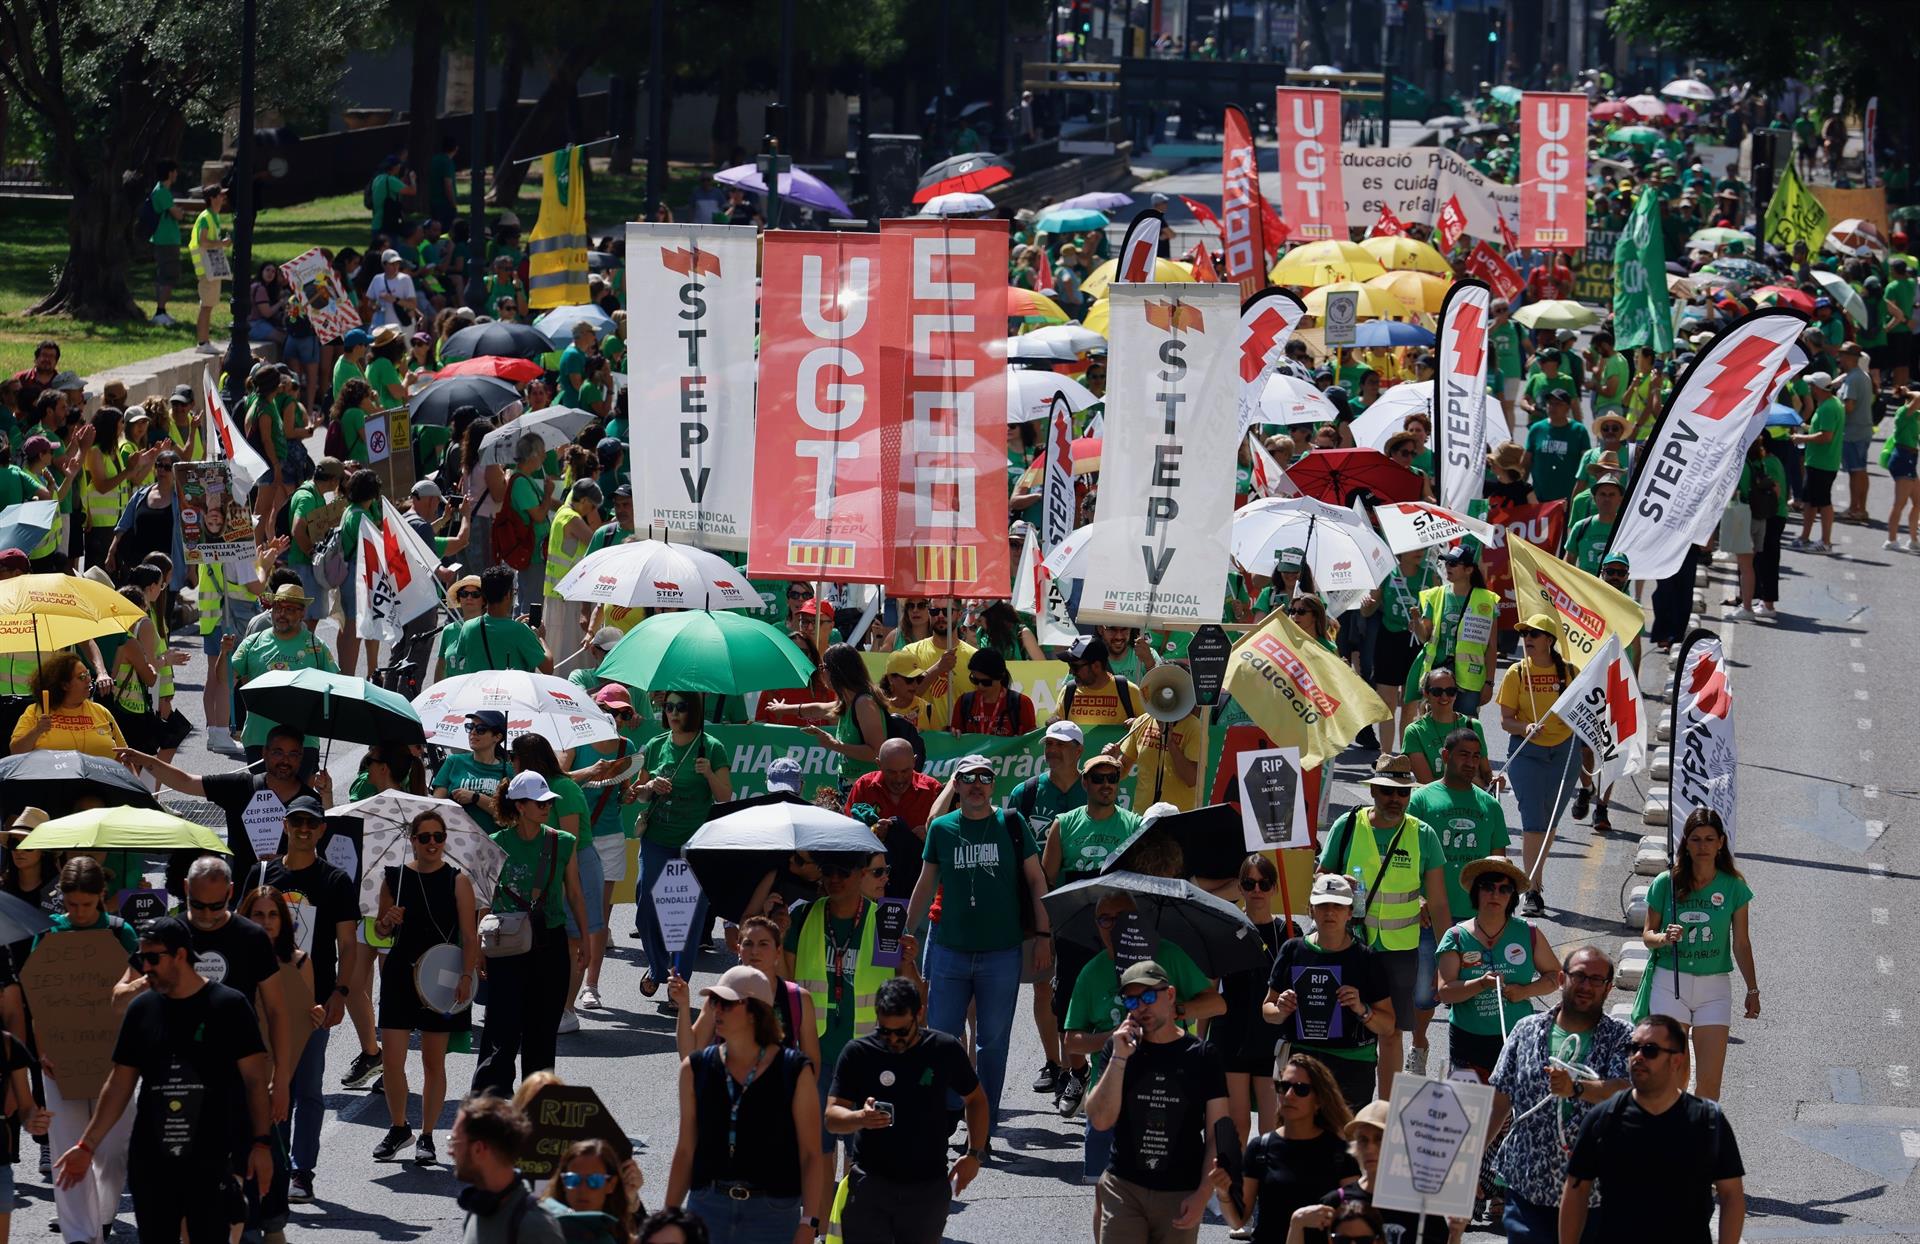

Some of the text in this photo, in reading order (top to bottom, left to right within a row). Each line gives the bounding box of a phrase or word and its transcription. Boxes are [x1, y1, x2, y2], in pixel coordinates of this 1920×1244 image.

[1293, 98, 1326, 218] UGT
[1537, 102, 1570, 221] UGT
[1363, 176, 1383, 190] es
[1363, 200, 1383, 212] es
[678, 283, 711, 503] STEPV
[795, 255, 869, 519] UGT
[391, 414, 408, 422] CAUTION
[1447, 379, 1470, 470] STEPV
[1141, 340, 1188, 585] STEPV
[1638, 419, 1700, 524] STEPV
[1663, 435, 1716, 530] INTERSINDICAL
[1684, 441, 1728, 518] VALENCIANA
[1048, 467, 1069, 546] STEPV
[653, 508, 736, 524] INTERSINDICAL
[667, 521, 736, 535] VALENCIANA
[1492, 517, 1549, 547] ROU
[656, 590, 684, 598] STEPV
[1105, 590, 1201, 605] INTERSINDICAL
[1119, 603, 1199, 617] VALENCIANA
[1240, 650, 1321, 725] educació
[555, 698, 579, 708] STEPV
[1071, 707, 1117, 717] educació
[1261, 759, 1283, 773] RIP
[256, 793, 273, 802] RIP
[246, 806, 284, 816] CEIP SERRA
[954, 846, 964, 865] LA
[666, 864, 688, 877] RIP
[676, 885, 688, 893] LES
[136, 899, 153, 909] RIP
[655, 896, 697, 905] RONDALLES
[887, 906, 900, 914] RIP
[1311, 974, 1329, 984] RIP
[540, 1099, 600, 1128] RIP
[1428, 1108, 1448, 1120] CEIP
[1416, 1146, 1447, 1158] CANALS
